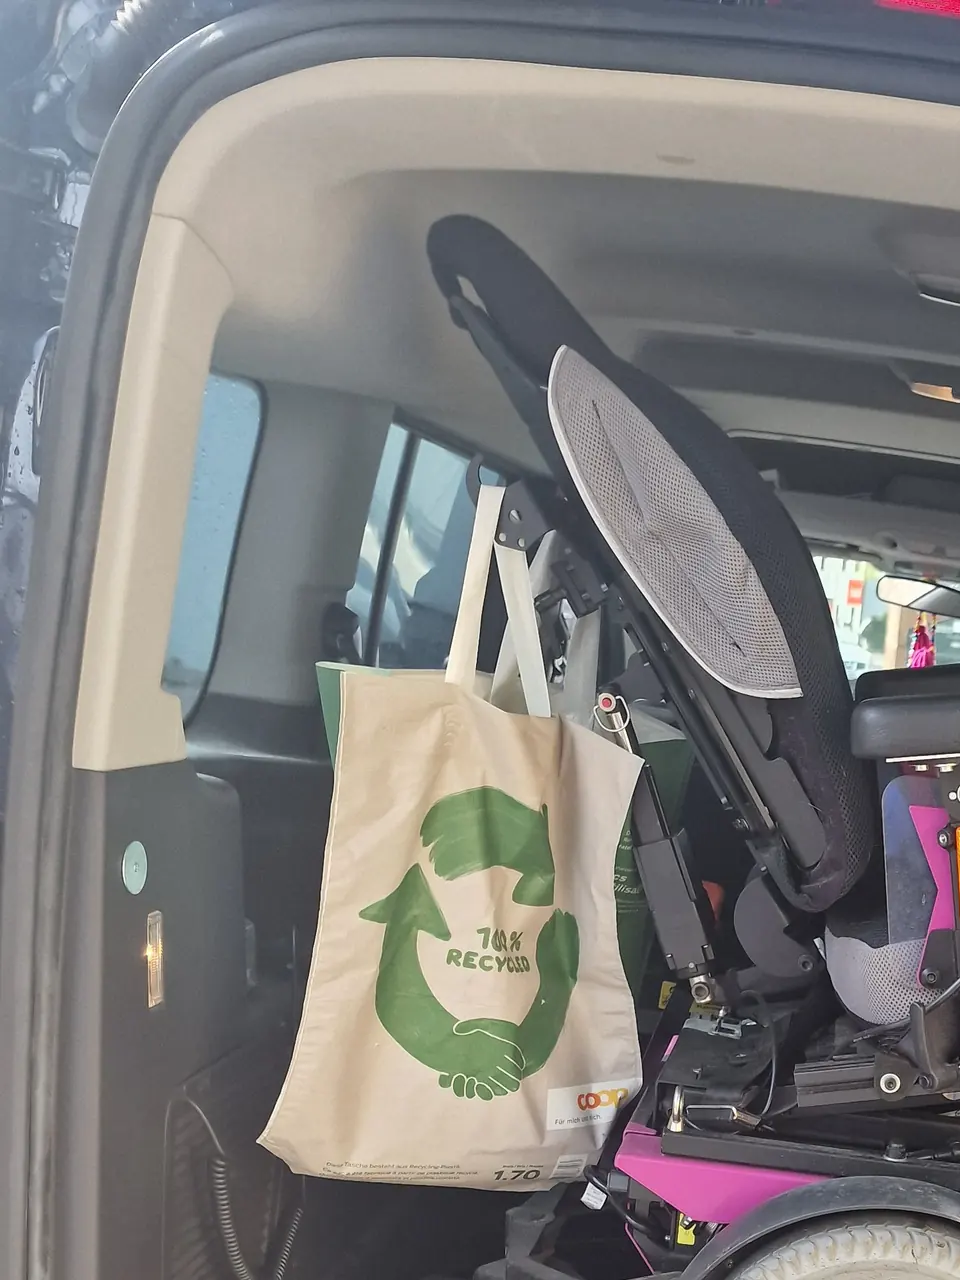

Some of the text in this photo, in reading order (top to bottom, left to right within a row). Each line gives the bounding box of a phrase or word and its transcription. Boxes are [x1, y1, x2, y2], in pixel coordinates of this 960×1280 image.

[476, 926, 524, 953] 100%
[445, 948, 531, 974] RECYCLED
[493, 1169, 541, 1181] 1.70
